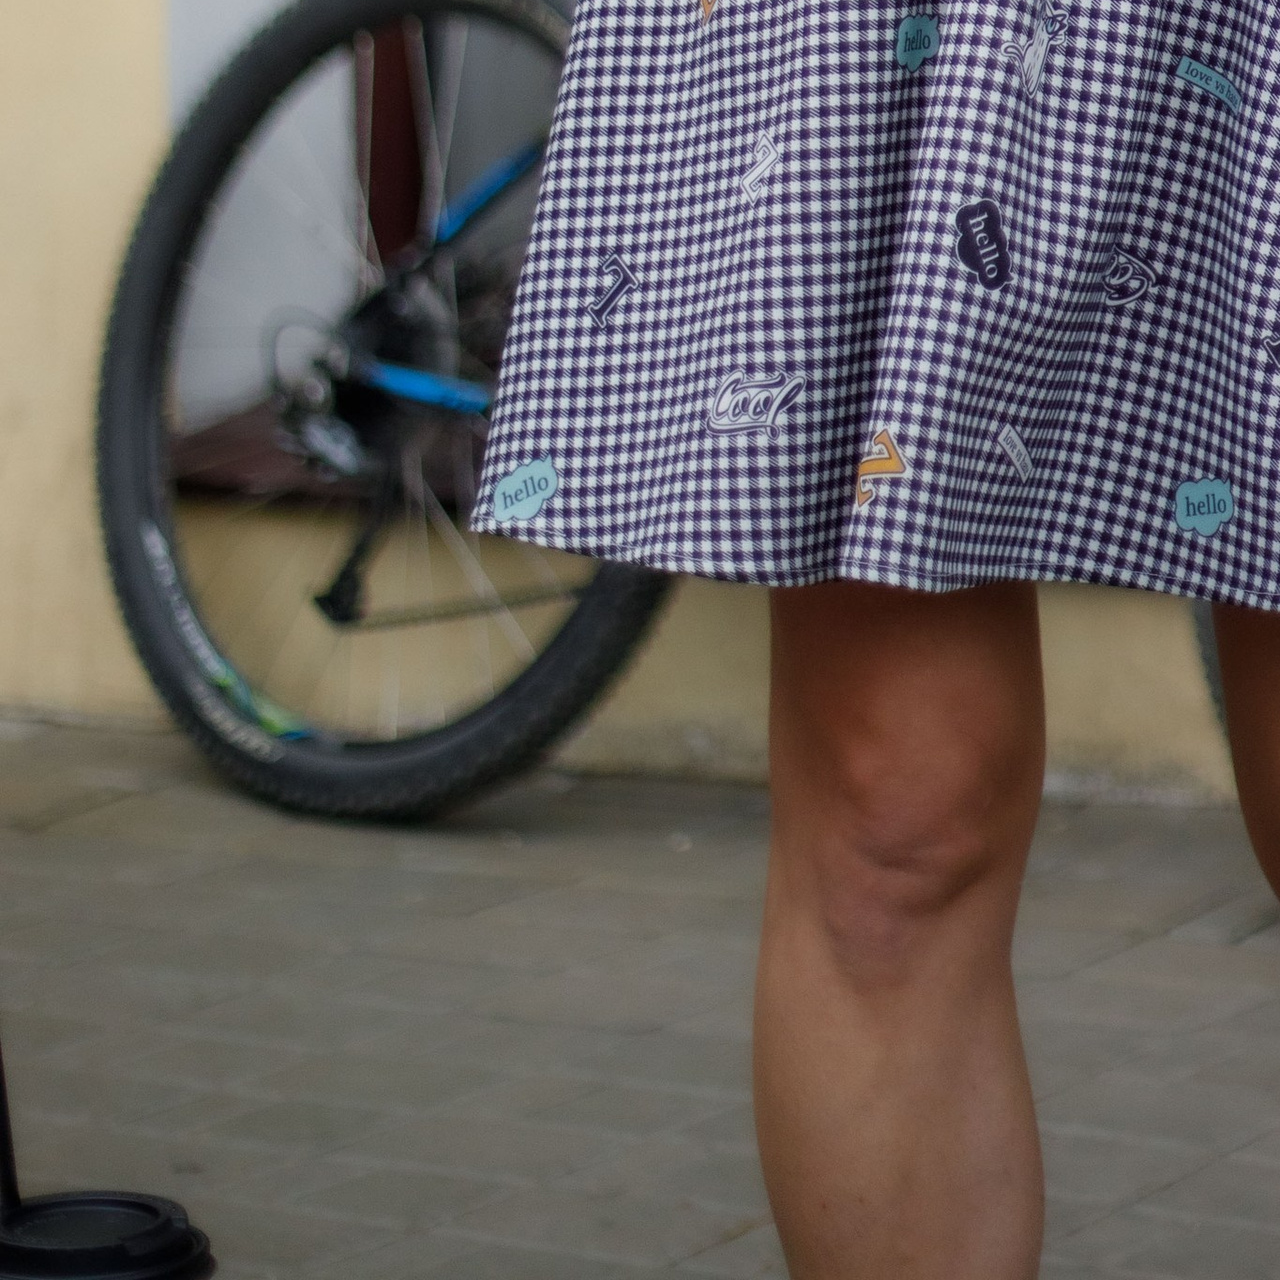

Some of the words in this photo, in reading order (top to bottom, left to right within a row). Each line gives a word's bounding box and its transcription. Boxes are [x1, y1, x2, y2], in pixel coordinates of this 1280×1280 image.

[903, 29, 931, 53] hello
[1185, 63, 1213, 86] love
[1213, 78, 1227, 95] vs
[969, 211, 999, 280] hello
[707, 369, 806, 441] Cool
[1002, 428, 1018, 453] love
[501, 476, 549, 510] hello
[1185, 493, 1227, 517] hello
